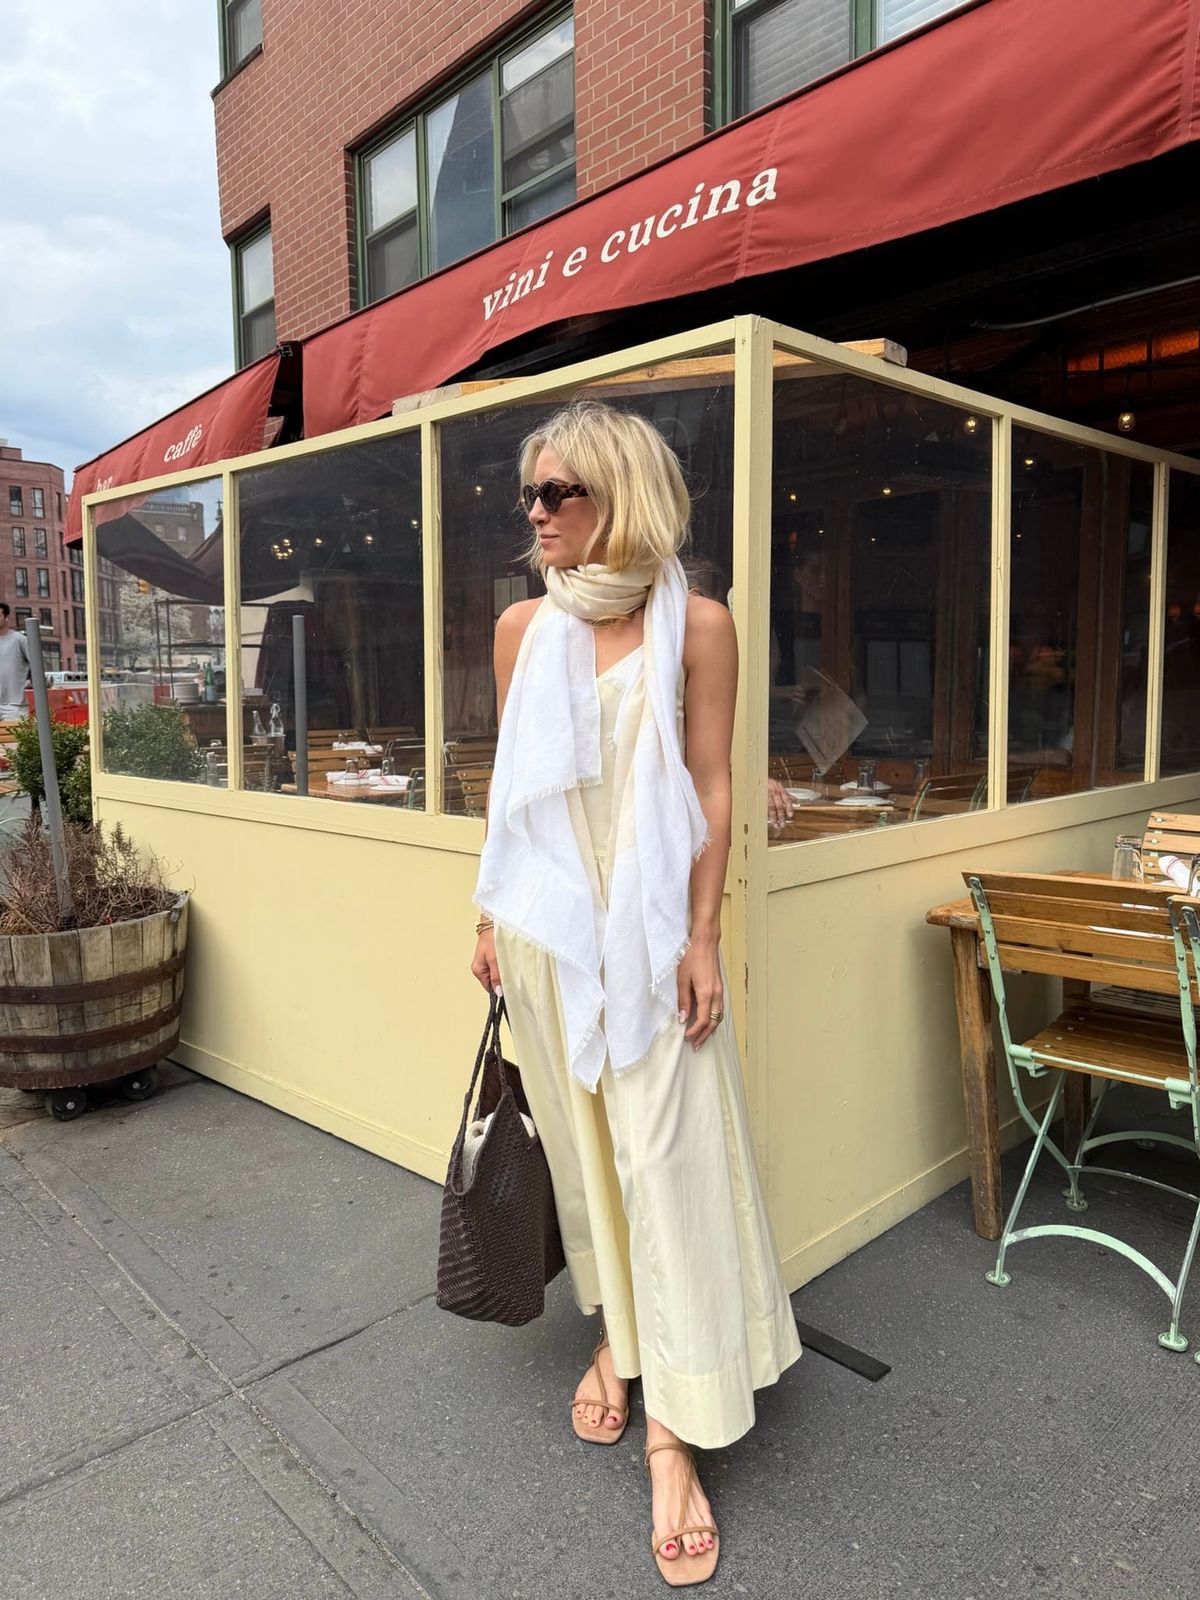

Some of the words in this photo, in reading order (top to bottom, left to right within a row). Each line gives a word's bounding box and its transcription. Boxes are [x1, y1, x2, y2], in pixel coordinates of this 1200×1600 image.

[481, 250, 554, 321] vini
[562, 246, 588, 278] e
[600, 167, 778, 264] cucina
[163, 423, 203, 463] caffè
